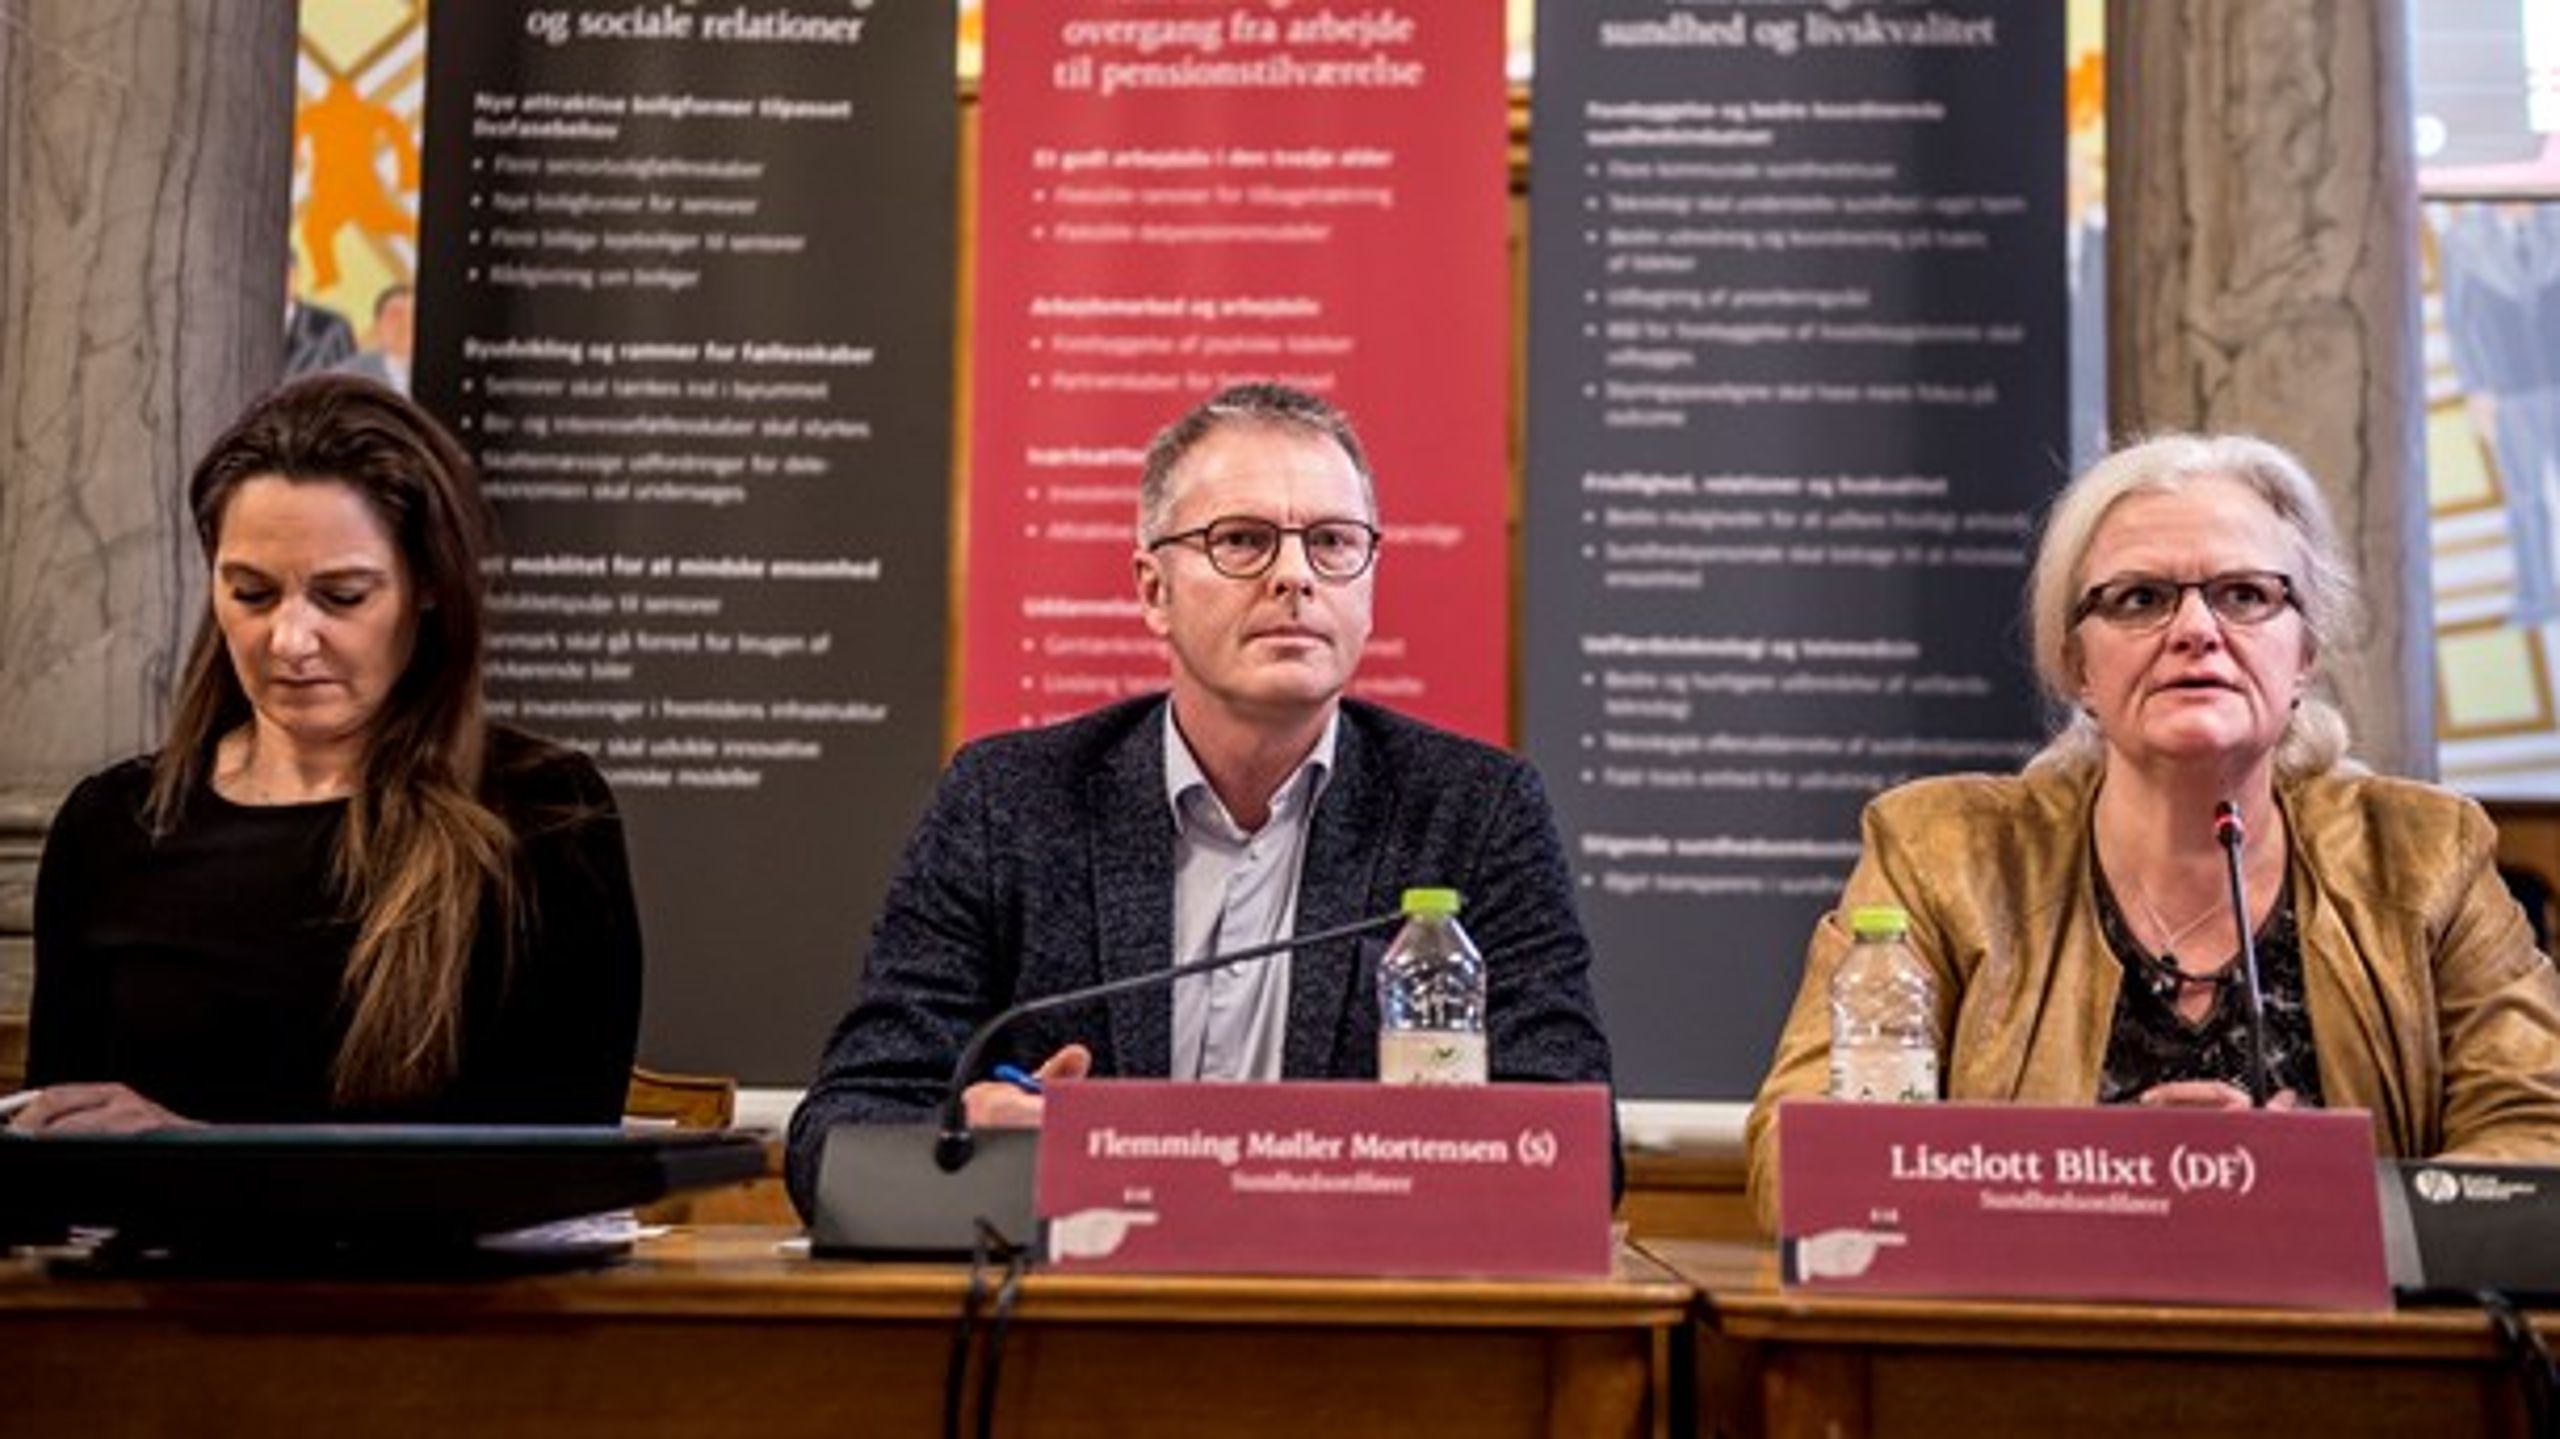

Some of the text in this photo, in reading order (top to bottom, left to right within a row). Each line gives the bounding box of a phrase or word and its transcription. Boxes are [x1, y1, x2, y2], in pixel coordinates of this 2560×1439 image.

[527, 4, 863, 45] og sociale relationer
[1062, 10, 1414, 52] overgang fra arbejde
[1601, 13, 1995, 54] sundhed og livskvalitet
[1054, 52, 1423, 96] til pensionstilværelse
[475, 93, 851, 119] Nye attraktive boligformer tilpasset
[1721, 105, 1747, 122] og
[649, 195, 674, 211] for
[1188, 300, 1216, 319] og
[465, 337, 873, 364] Byudvikling og rammer for fællesskaber
[571, 380, 607, 396] skal
[523, 418, 547, 437] og
[762, 419, 797, 436] skal
[751, 455, 778, 473] for
[593, 482, 630, 500] skal
[1807, 479, 1833, 497] og
[512, 557, 606, 575] mobilitet
[613, 557, 643, 575] for
[650, 558, 672, 576] at
[678, 558, 765, 577] mindske
[770, 560, 880, 578] ensomhed
[485, 634, 558, 651] anmark
[566, 634, 602, 651] skal
[810, 634, 830, 653] af
[1770, 641, 1796, 660] og
[608, 739, 644, 757] skal
[1089, 1130, 1558, 1166] Flemming Møller Mortensen (S)
[1892, 1145, 2255, 1193] Liselott Blixt (DF)
[1232, 1172, 1412, 1192] Sundhedsordfører
[1981, 1190, 2170, 1214] Sundhedsordfører
